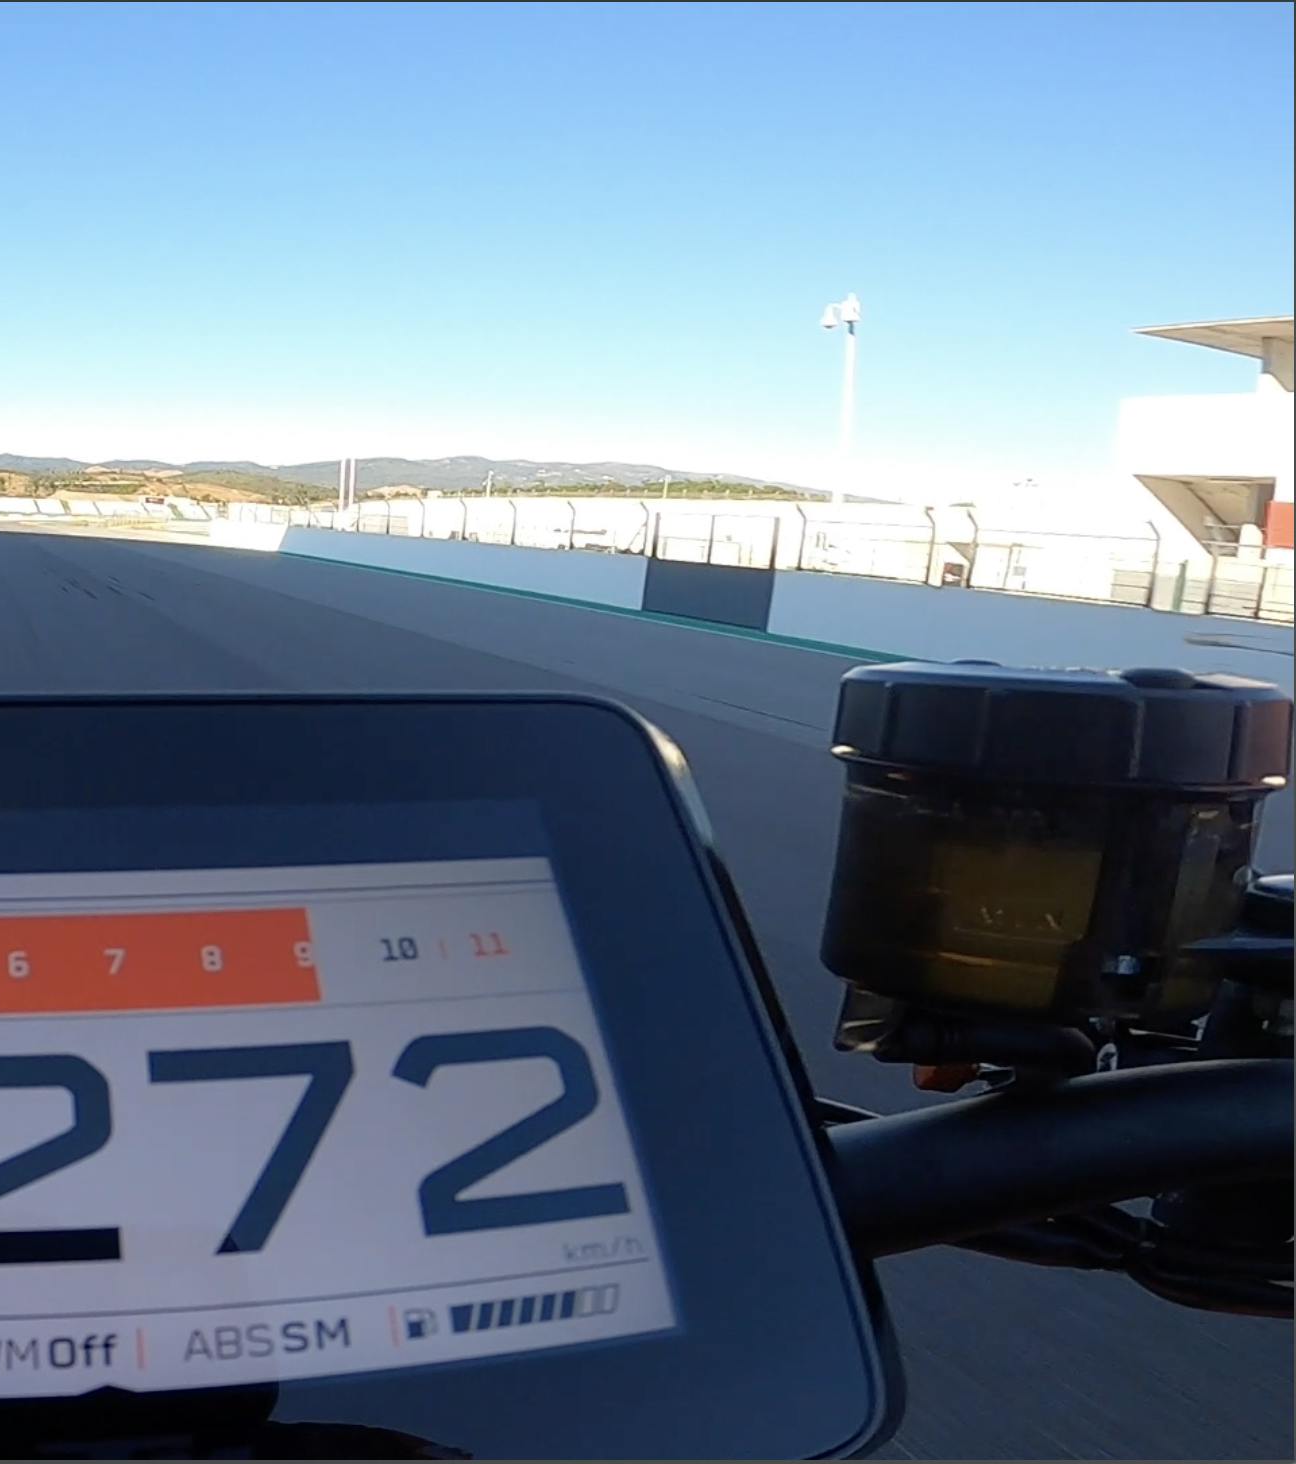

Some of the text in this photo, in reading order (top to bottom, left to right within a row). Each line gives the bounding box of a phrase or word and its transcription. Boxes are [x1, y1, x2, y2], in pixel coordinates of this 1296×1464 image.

[7, 951, 30, 977] 6
[104, 948, 125, 975] 7
[200, 944, 223, 972] 8
[380, 937, 419, 962] 10
[469, 932, 509, 957] 11
[562, 1235, 644, 1262] km/h
[49, 1333, 117, 1369] Off
